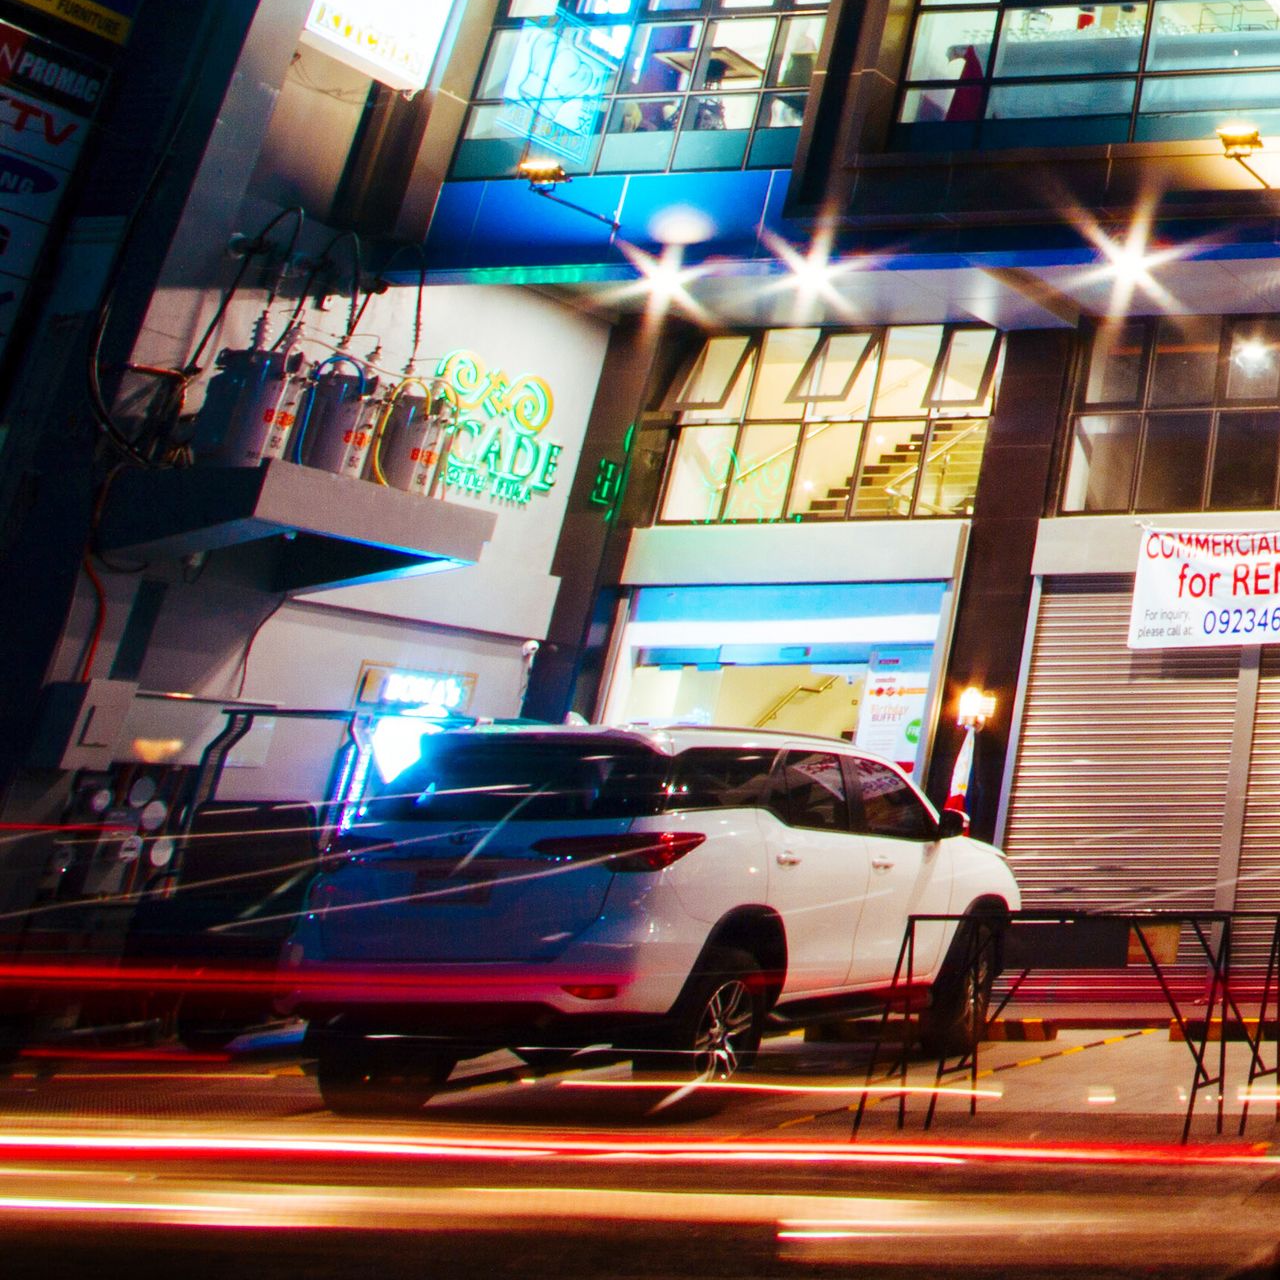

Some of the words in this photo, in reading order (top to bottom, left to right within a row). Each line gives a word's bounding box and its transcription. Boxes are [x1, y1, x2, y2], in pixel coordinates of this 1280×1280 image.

[17, 52, 100, 103] PROMAC
[447, 418, 563, 492] CADE
[1178, 563, 1221, 598] for
[1145, 609, 1158, 621] For
[872, 713, 901, 722] BUFFET
